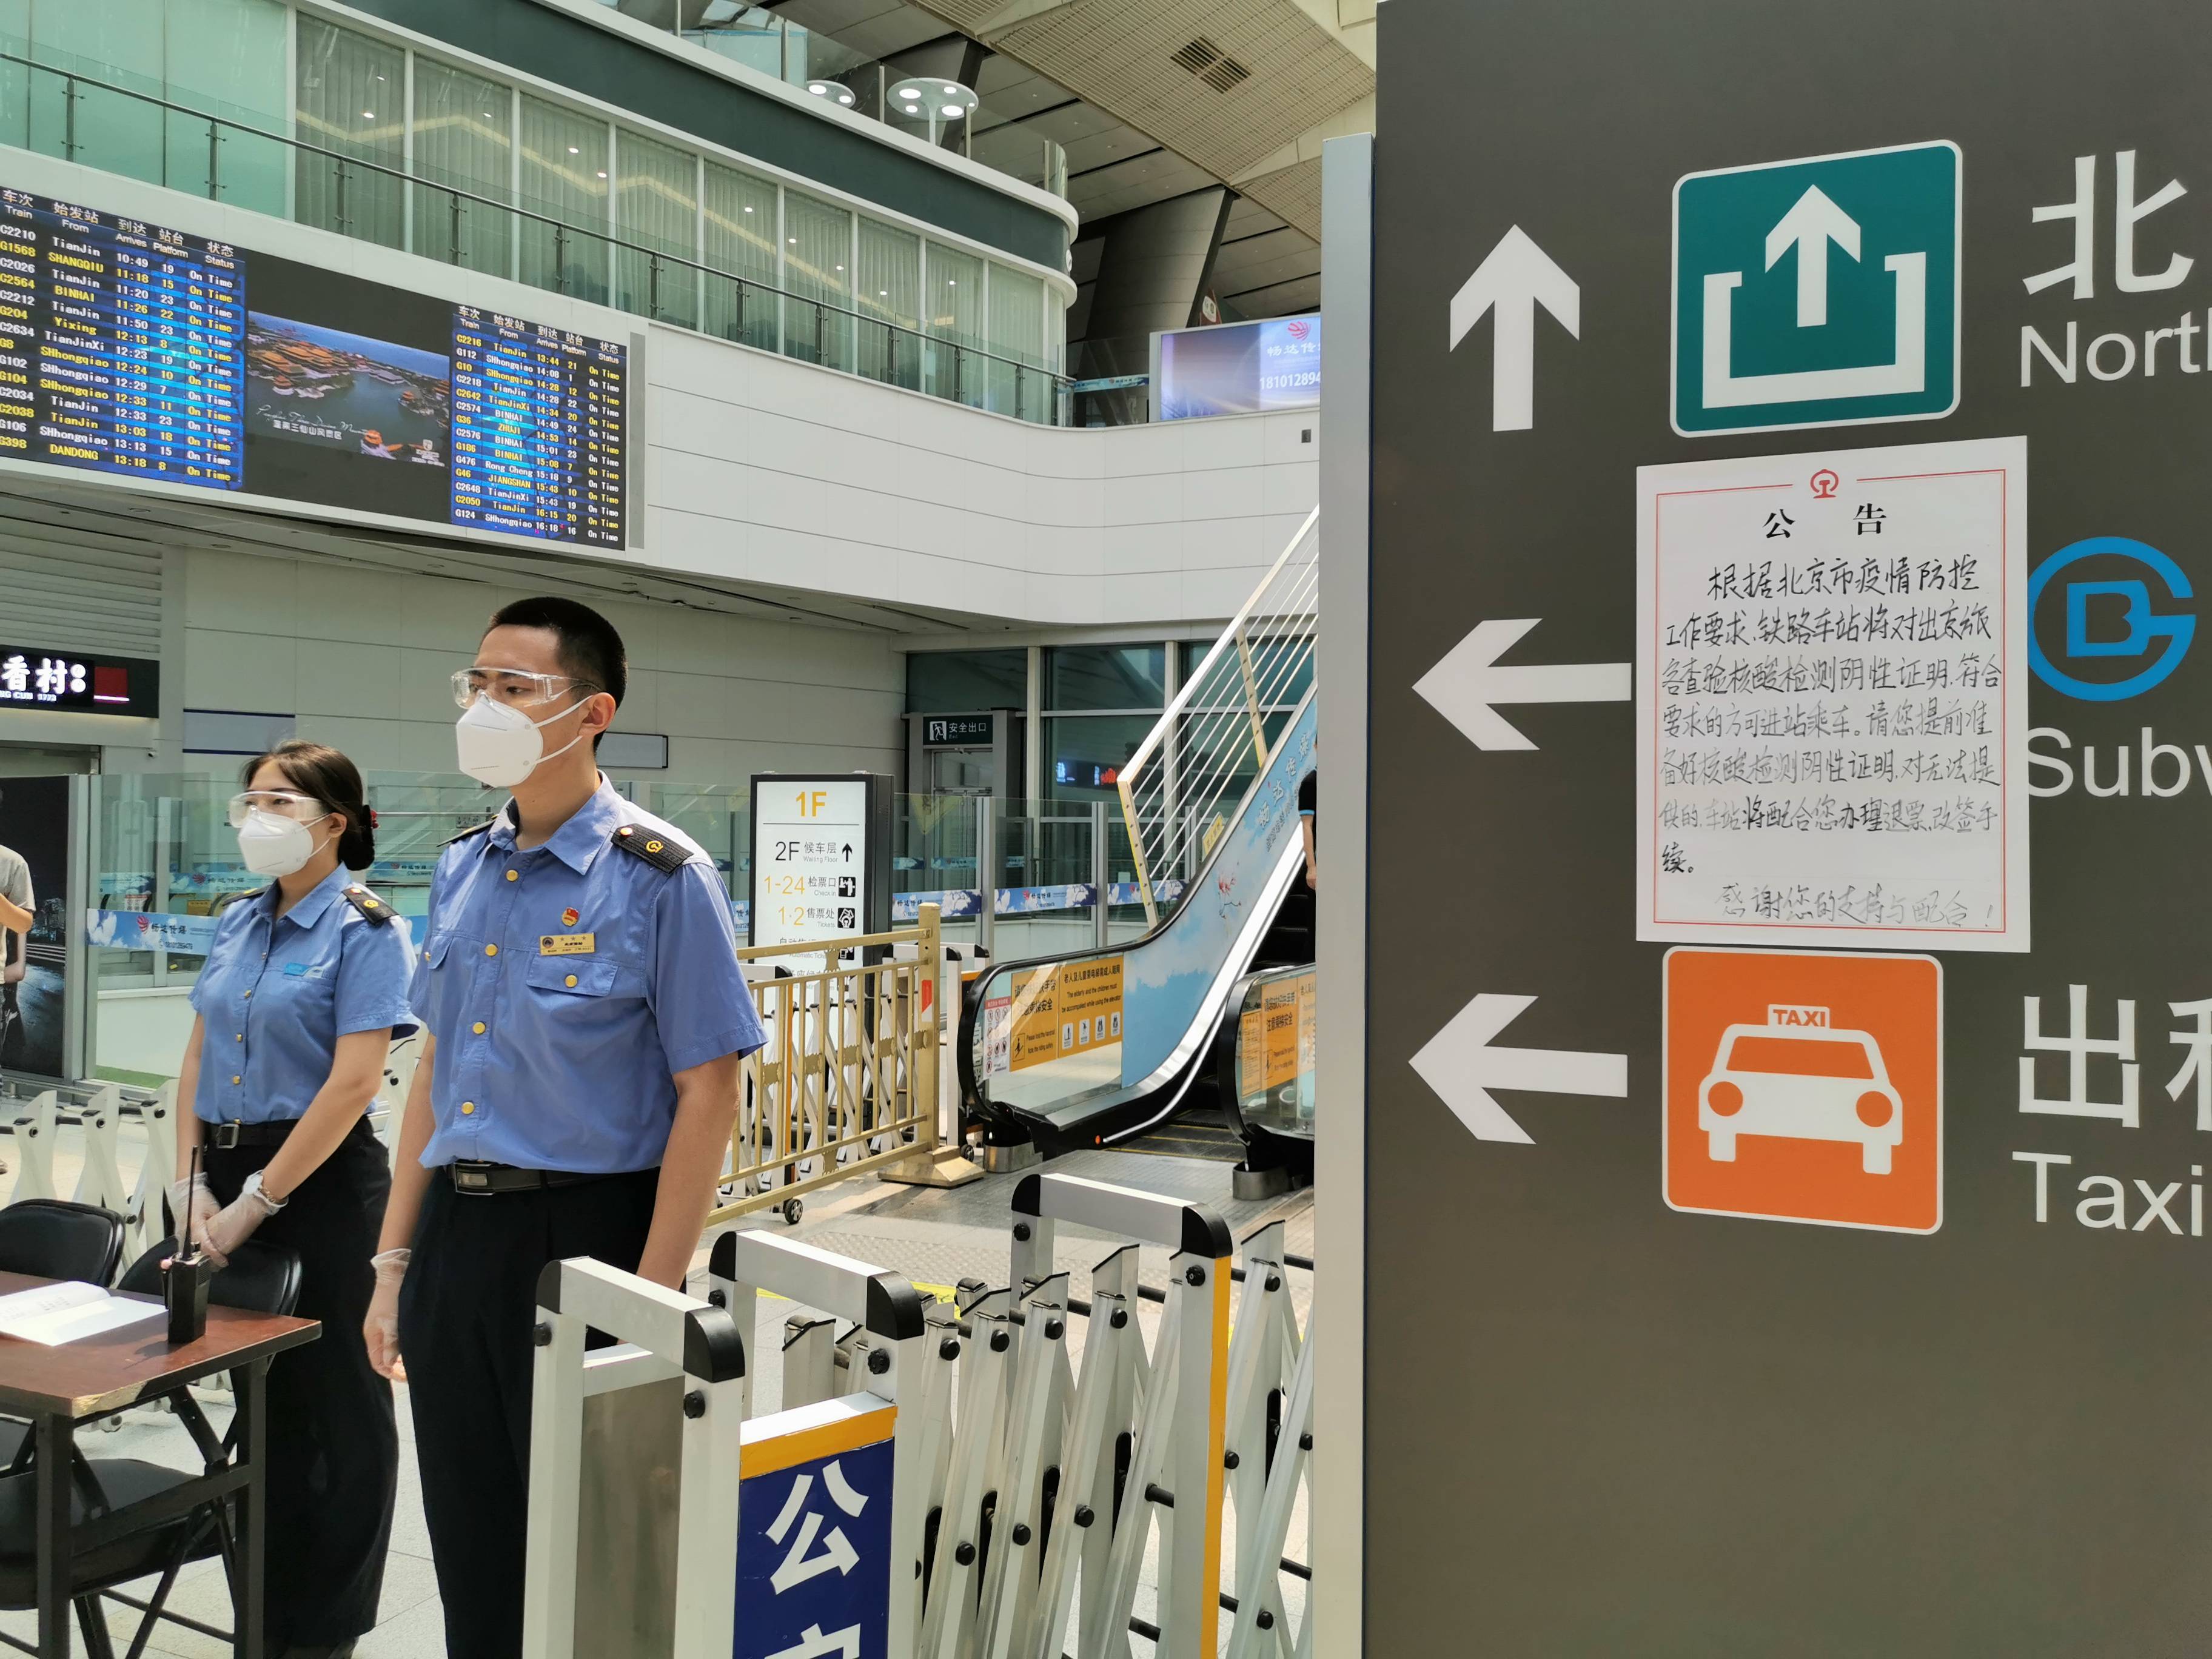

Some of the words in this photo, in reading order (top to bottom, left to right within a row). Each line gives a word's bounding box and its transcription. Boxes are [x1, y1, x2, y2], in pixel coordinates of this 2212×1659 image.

[3, 189, 33, 208] 车次
[54, 202, 99, 224] 始发站
[118, 218, 147, 237] 到达
[159, 228, 184, 245] 站台
[207, 241, 234, 258] 状态
[2022, 149, 2194, 300] 北
[0, 224, 36, 241] C2210
[53, 236, 100, 256] TianJin
[117, 253, 149, 268] 10:49
[4, 204, 33, 220] Train
[61, 219, 89, 234] From
[115, 233, 147, 249] Arrives
[153, 241, 189, 259] Platform
[205, 255, 235, 269] Status
[0, 240, 36, 257] G1568
[49, 252, 104, 273] SHANGQIU
[117, 268, 149, 283] 11:18
[0, 257, 35, 273] C2026
[53, 269, 100, 288] TianJin
[117, 284, 149, 300] 11:20
[0, 273, 35, 289] C2564
[55, 285, 95, 302] BINHAI
[116, 300, 148, 314] 11:26
[0, 290, 35, 306] C2212
[52, 301, 99, 320] TianJin
[116, 315, 149, 330] 11:50
[0, 305, 27, 320] G204
[55, 317, 97, 336] Yixing
[116, 330, 147, 344] 12:13
[458, 304, 481, 320] 车次
[493, 313, 525, 332] 始发站
[537, 324, 558, 340] 到达
[565, 331, 584, 347] 站台
[599, 341, 619, 355] 状态
[0, 321, 35, 337] C2634
[45, 330, 104, 351] TianJinXi
[116, 346, 149, 360] 12:23
[456, 334, 481, 347] C2216
[494, 343, 527, 358] TianJin
[460, 318, 480, 330] Train
[498, 328, 518, 340] From
[536, 338, 558, 350] Arrives
[561, 343, 587, 357] Platform
[598, 352, 620, 364] Status
[1267, 342, 1321, 357] 畅达传
[41, 346, 109, 367] SHhongqiao
[116, 361, 147, 375] 12:24
[456, 347, 477, 360] G112
[486, 354, 534, 373] SHhongqiao
[40, 363, 109, 384] SHhongqiao
[116, 377, 147, 391] 12:29
[456, 361, 472, 372] G10
[486, 368, 534, 386] SHhongqiao
[456, 374, 481, 387] C2218
[494, 383, 526, 397] TianJin
[40, 378, 109, 400] SHhongqiao
[115, 393, 147, 406] 12:33
[456, 388, 481, 401] C2642
[489, 395, 529, 411] TianJinXi
[51, 395, 98, 413] TianJin
[115, 407, 147, 421] 12:33
[456, 401, 481, 413] C2574
[495, 409, 523, 423] BINHAI
[456, 414, 472, 424] G36
[51, 412, 98, 429] TianJin
[115, 424, 146, 437] 13:03
[39, 426, 108, 446] SHhongqiao
[115, 438, 147, 452] 13:13
[456, 427, 481, 440] C2576
[495, 435, 523, 448] BINHAI
[50, 443, 99, 460] DANDONG
[115, 455, 147, 468] 13:18
[455, 441, 476, 453] G186
[494, 449, 523, 461] BINHAI
[455, 455, 476, 466] G476
[485, 460, 506, 473] Rong
[455, 468, 471, 478] G46
[488, 474, 531, 489] JIANGSHAN
[455, 481, 481, 494] C2648
[488, 487, 529, 501] TianJinXi
[455, 495, 481, 506] C2050
[493, 501, 526, 514] TianJin
[455, 509, 475, 519] G124
[485, 513, 532, 528] SHhongqiao
[1706, 554, 1980, 602] 根据北京市疫情防控
[37, 693, 57, 702] 1773
[948, 722, 987, 733] 安全出口
[796, 791, 827, 817] 1F
[775, 841, 800, 861] 2F
[804, 841, 837, 854] 候车层
[763, 876, 806, 895] 1-24
[808, 876, 836, 888] 检票口
[806, 908, 835, 919] 售票处
[1773, 1008, 1826, 1028] TAXI
[2012, 1151, 2203, 1236] Taxi
[764, 1458, 870, 1659] 公
